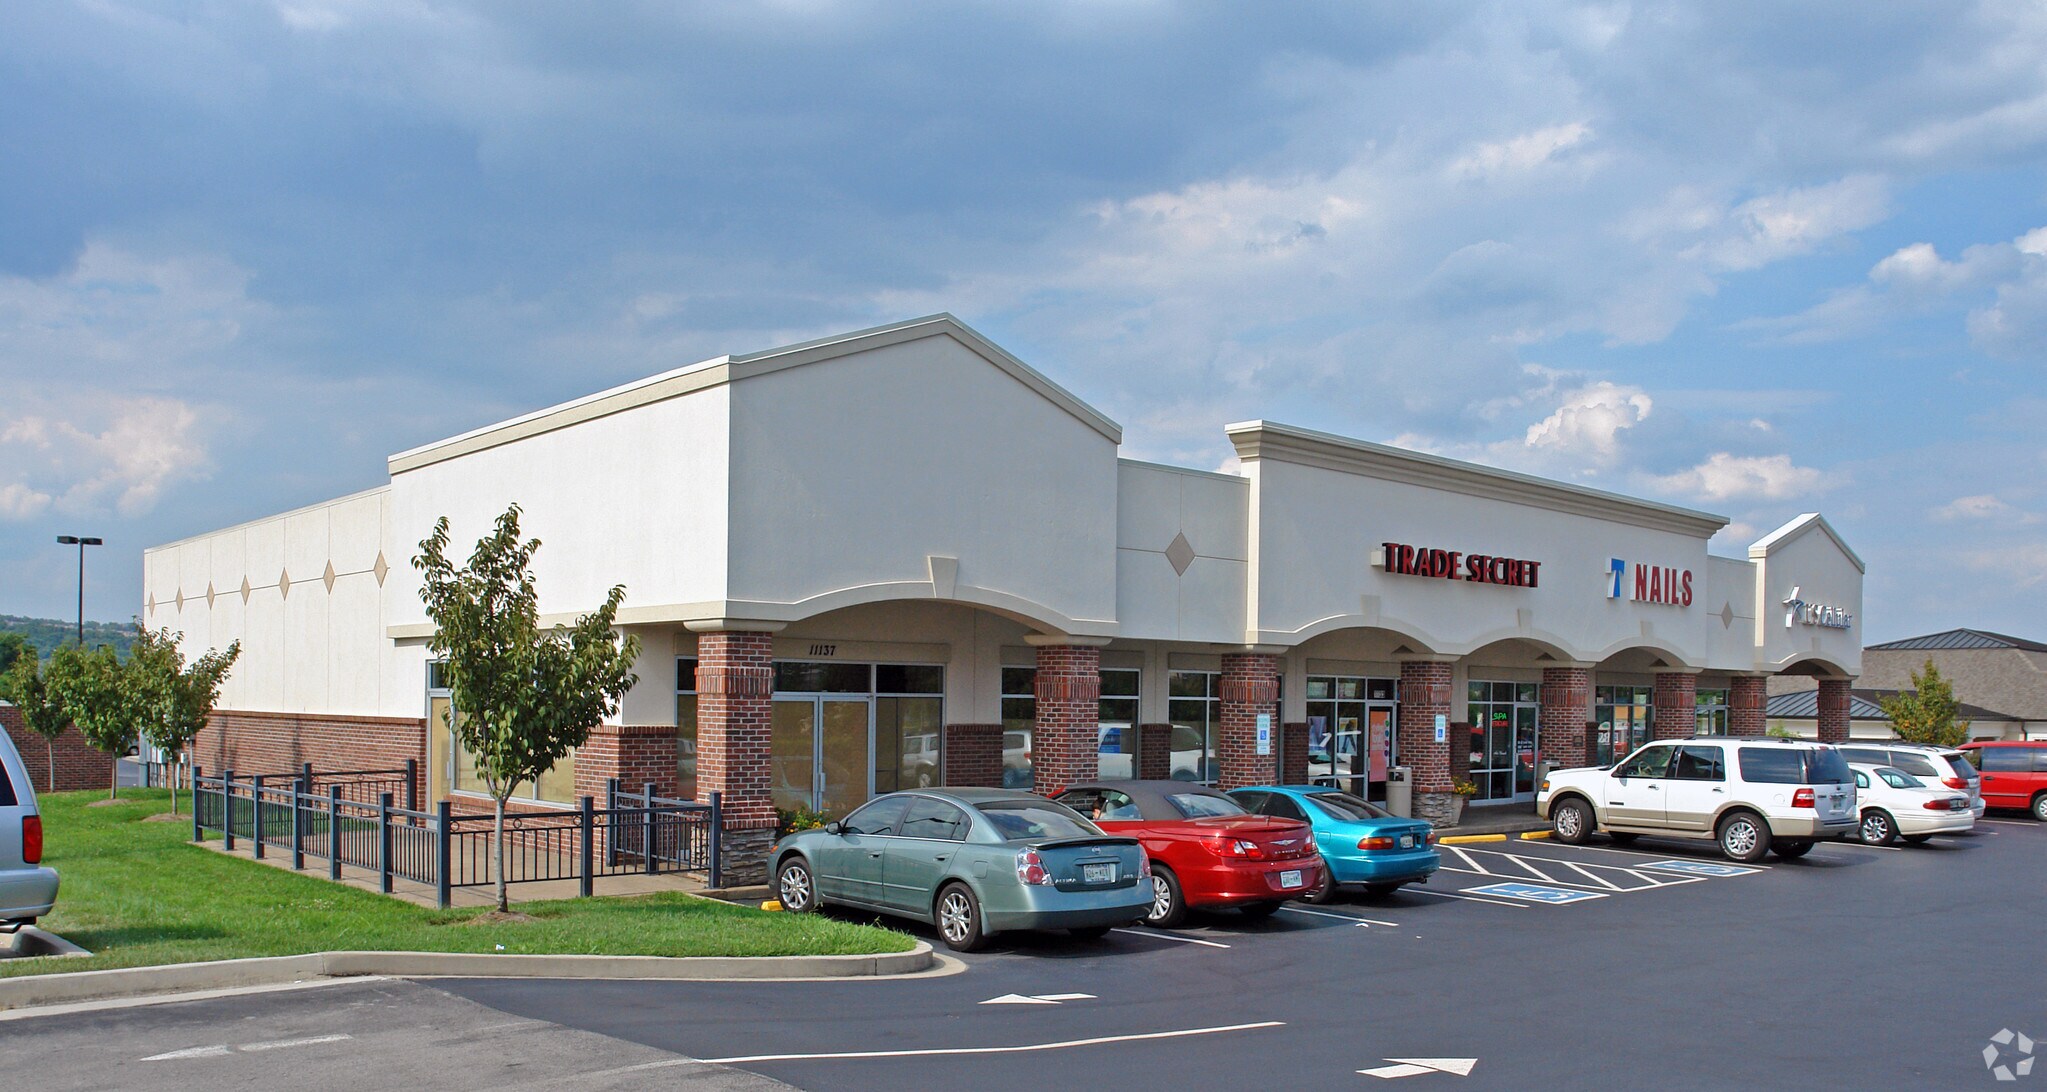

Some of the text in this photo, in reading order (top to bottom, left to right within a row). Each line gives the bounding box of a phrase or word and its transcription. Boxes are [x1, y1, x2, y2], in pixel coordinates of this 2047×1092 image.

[1382, 542, 1541, 588] TRADE SECRET
[1633, 563, 1692, 607] NAILS
[809, 644, 836, 656] 11137
[1493, 712, 1507, 720] SPA
